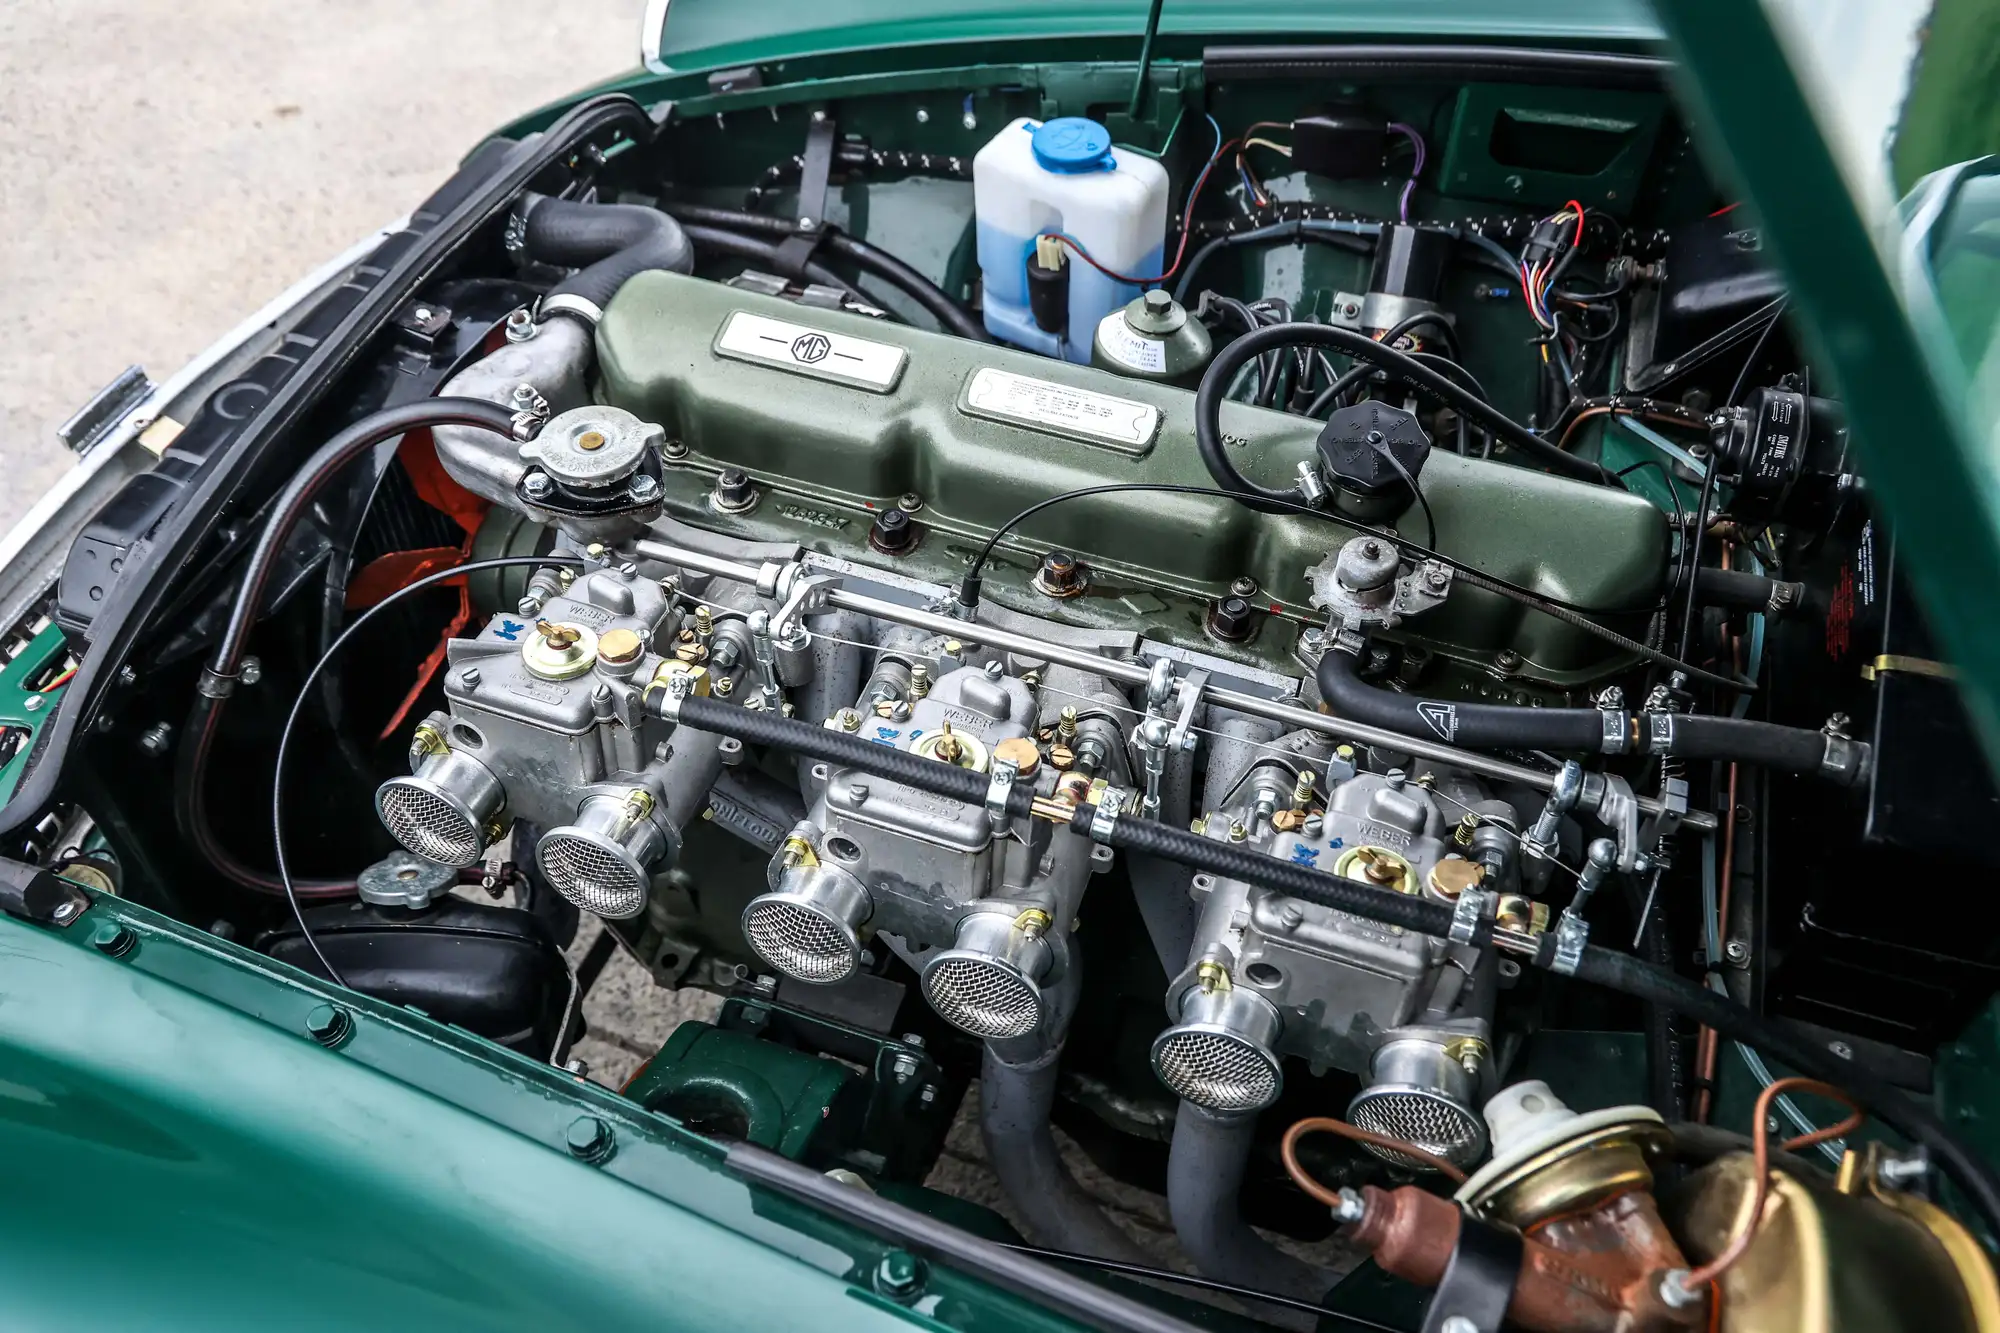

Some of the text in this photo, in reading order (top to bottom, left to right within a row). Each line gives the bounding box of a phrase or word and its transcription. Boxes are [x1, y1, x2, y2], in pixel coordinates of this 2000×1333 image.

[793, 334, 829, 363] MG
[1774, 434, 1789, 459] SMITHS
[568, 603, 616, 624] WEBER
[943, 707, 993, 729] WEBER
[1356, 821, 1411, 846] WEBER
